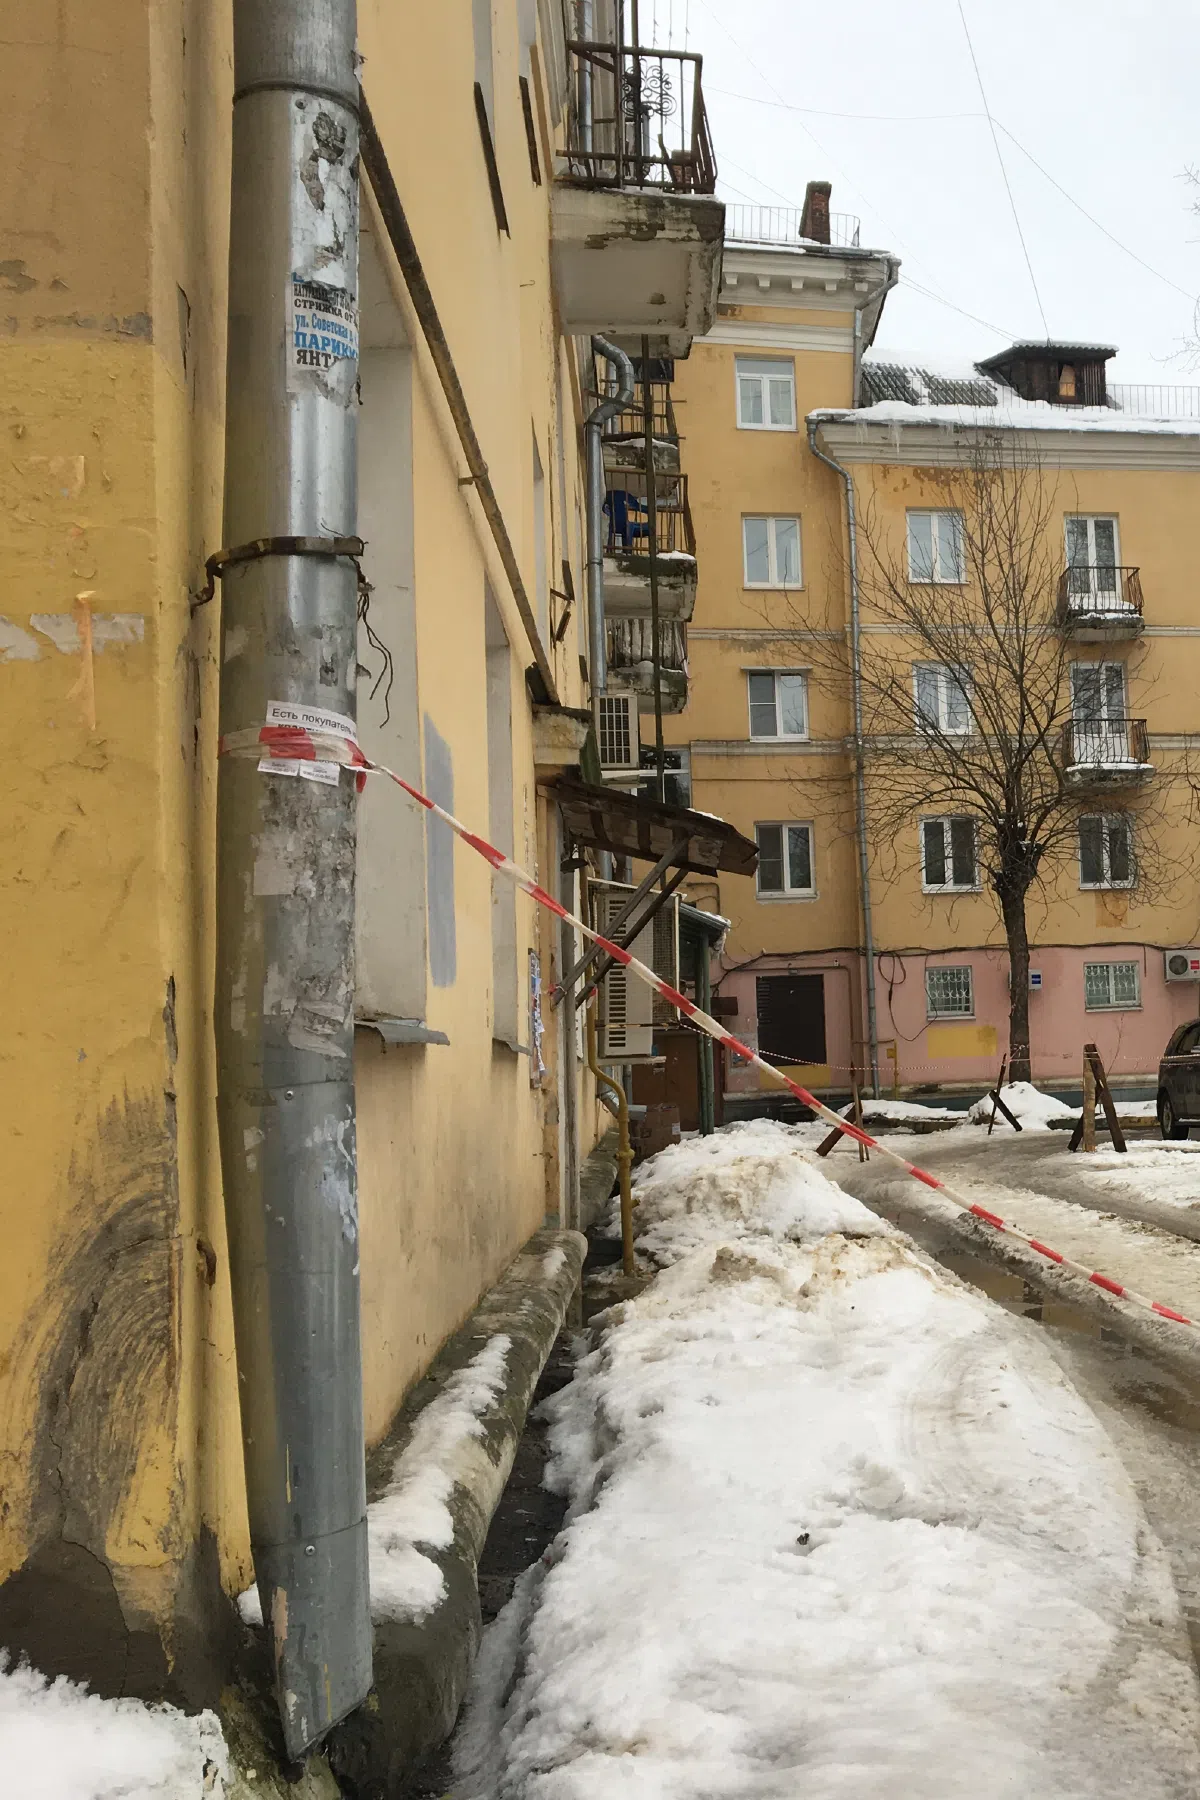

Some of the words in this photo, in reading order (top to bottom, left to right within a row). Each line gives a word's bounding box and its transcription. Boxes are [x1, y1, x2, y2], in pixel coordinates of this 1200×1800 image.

[294, 298, 343, 318] СТРИЖКА
[295, 314, 309, 331] ул.
[311, 312, 348, 339] Советская
[272, 708, 298, 720] Есть
